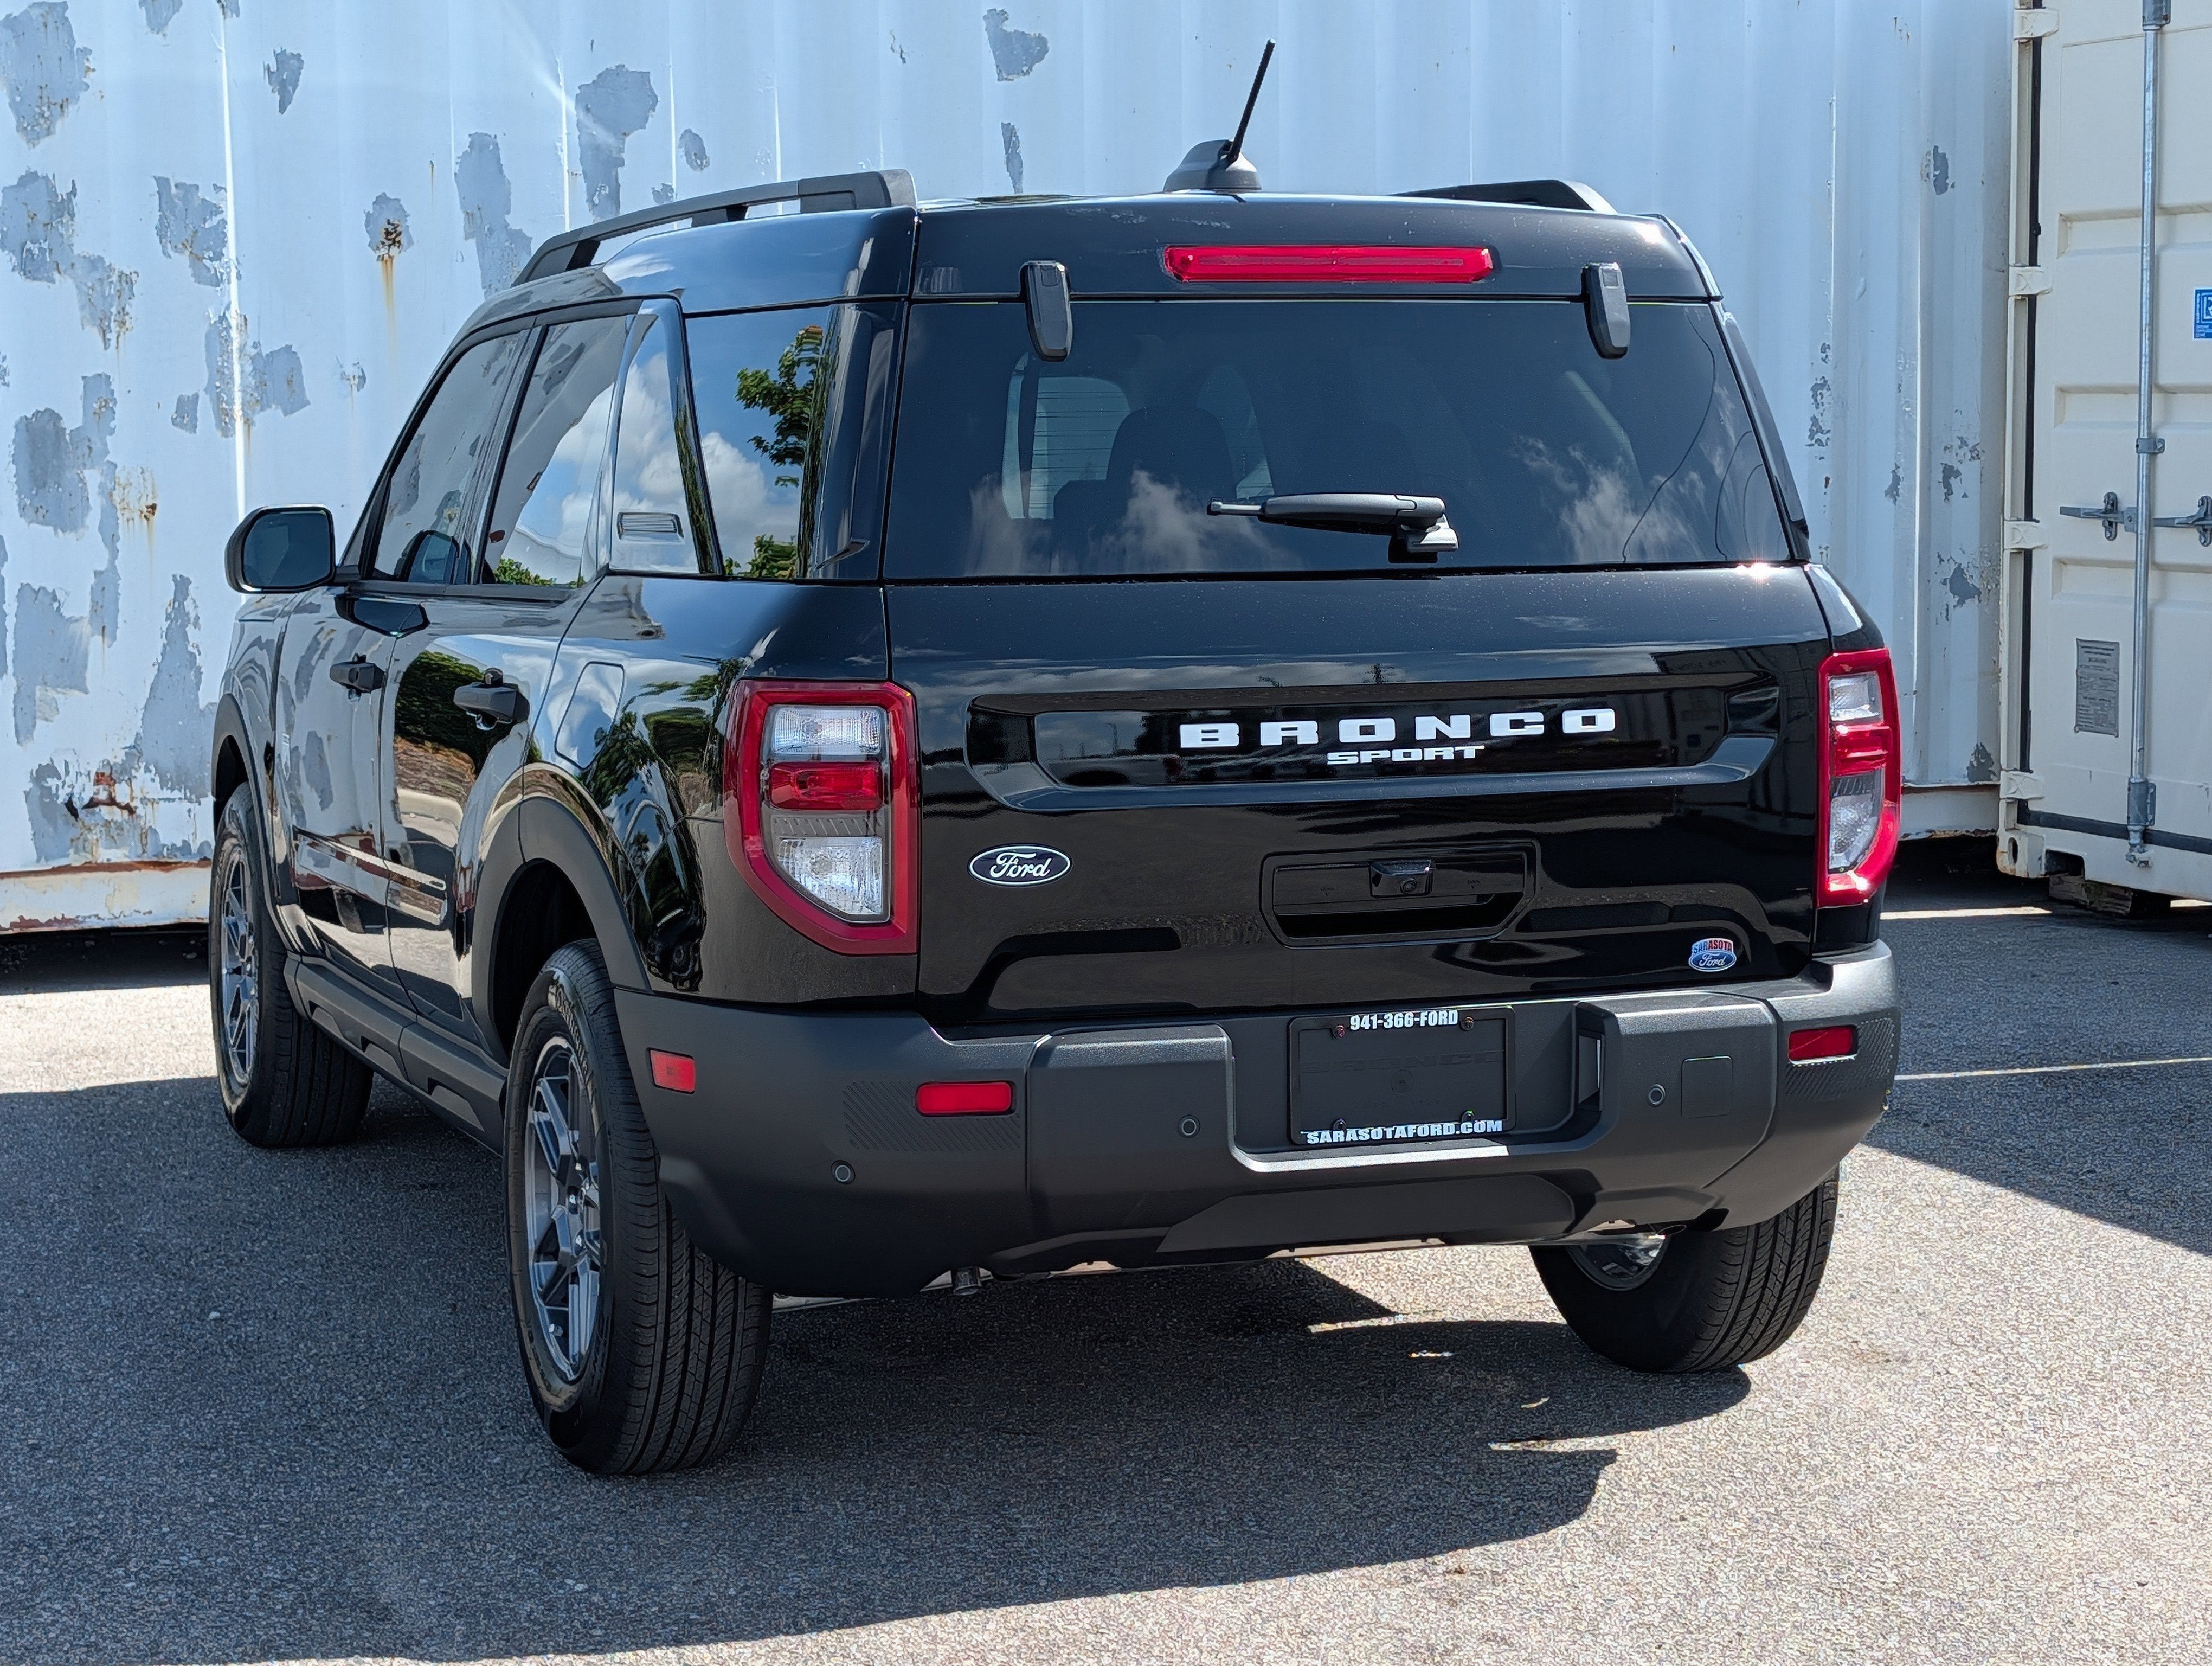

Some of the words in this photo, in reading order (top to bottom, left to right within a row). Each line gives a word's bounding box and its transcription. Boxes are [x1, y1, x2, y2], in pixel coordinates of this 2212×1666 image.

[1179, 708, 1615, 748] BRONCO
[1327, 745, 1485, 765] SPORT
[989, 852, 1052, 877] Ford
[1693, 940, 1732, 953] SARASOTA
[1699, 953, 1726, 966] Ford
[1349, 1009, 1458, 1030] 941-366-FORD
[1307, 1120, 1503, 1144] SARASOTAFORD.COM
